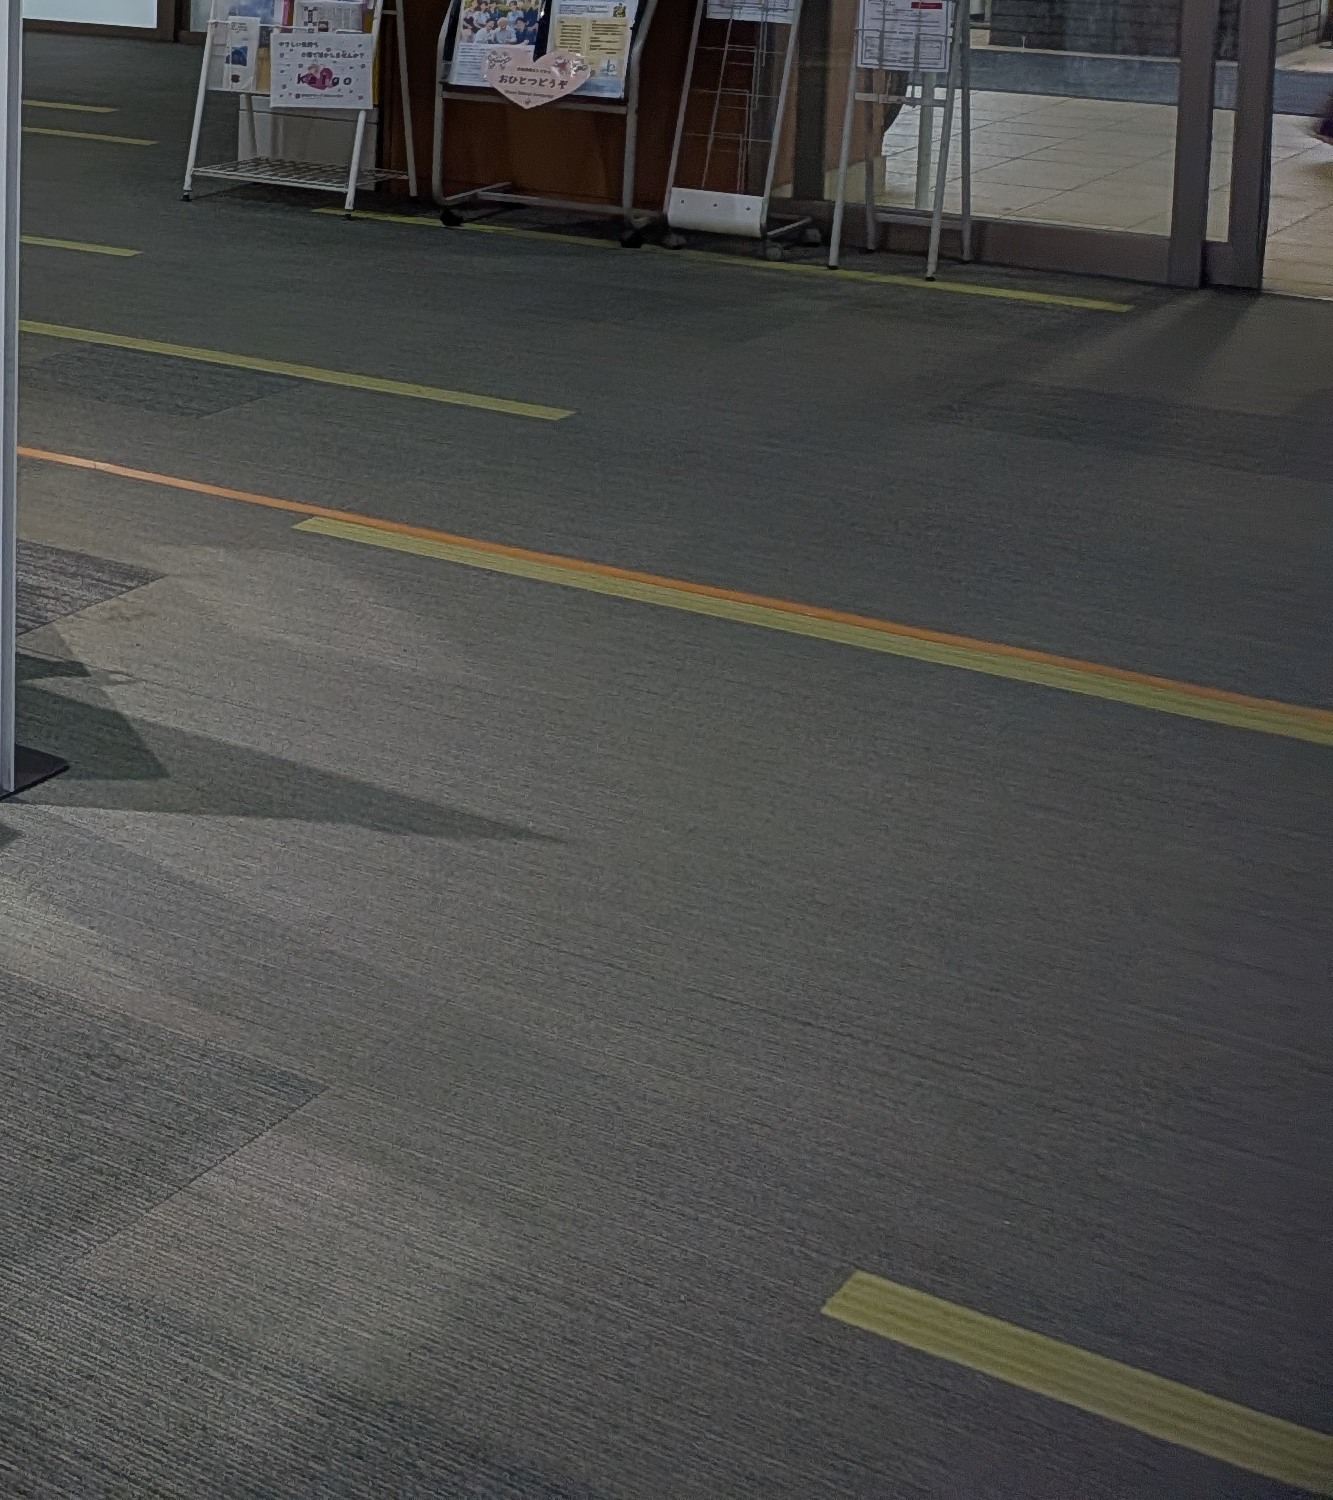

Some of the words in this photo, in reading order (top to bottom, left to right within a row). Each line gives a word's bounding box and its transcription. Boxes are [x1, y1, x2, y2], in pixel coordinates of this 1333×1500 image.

[499, 74, 569, 88] おひとつどうぞ
